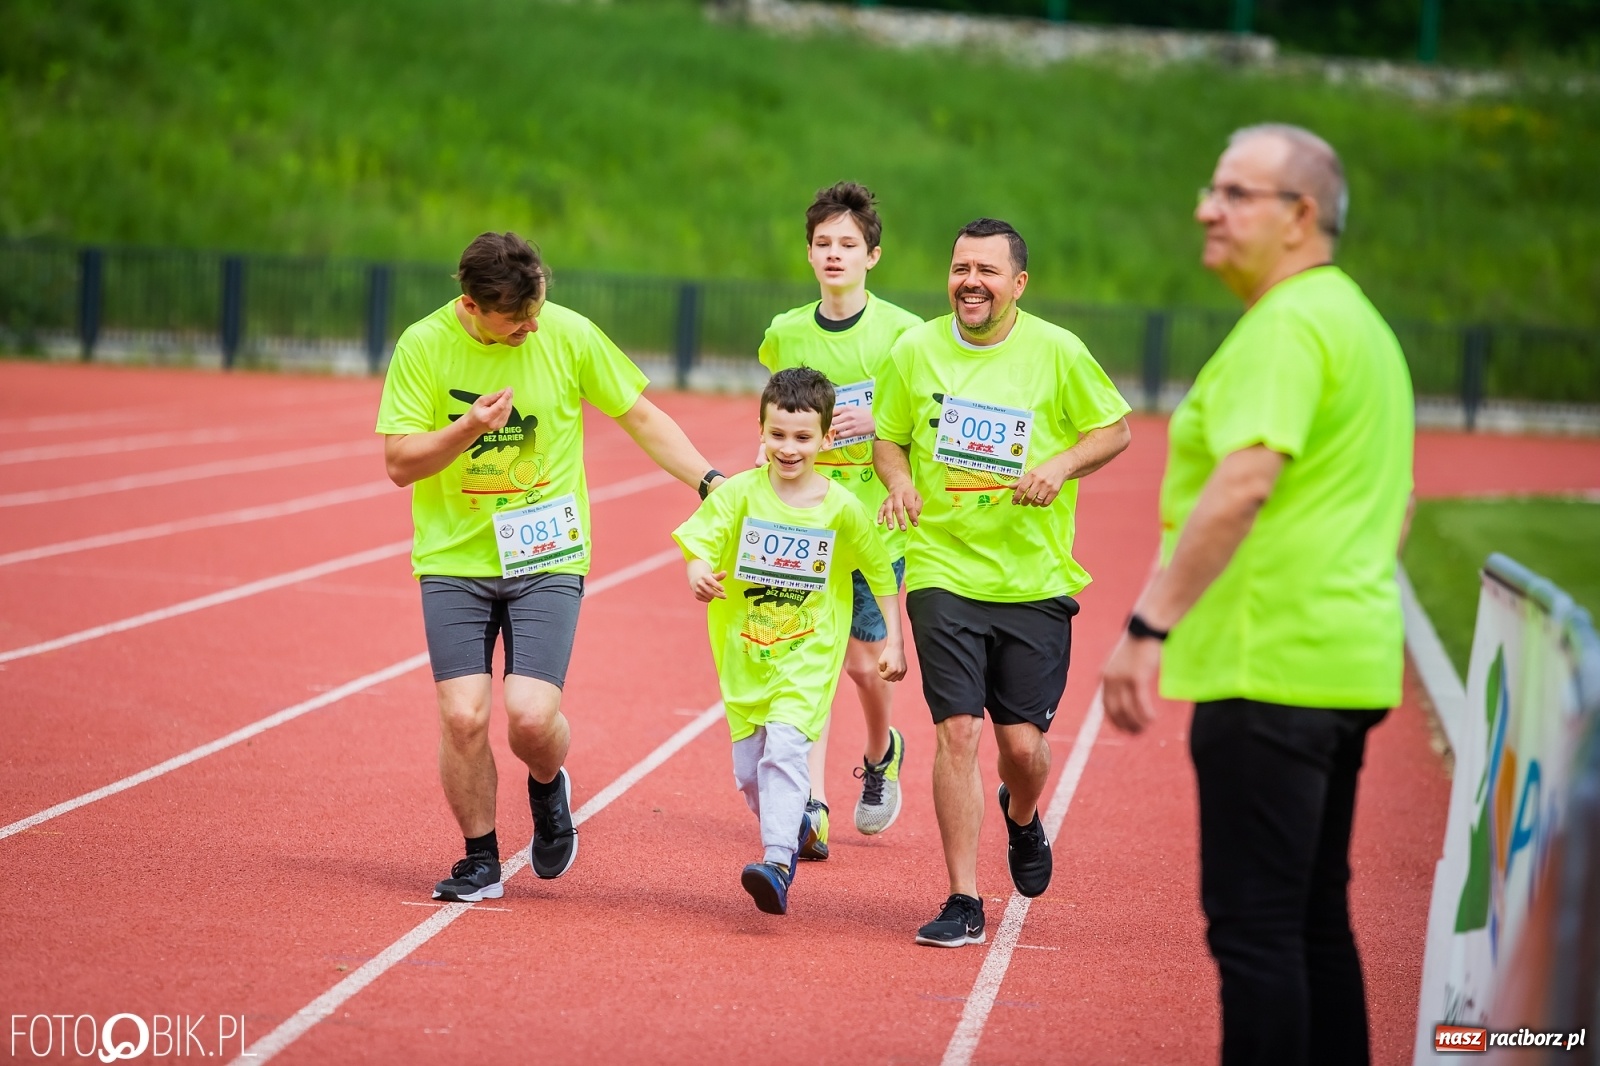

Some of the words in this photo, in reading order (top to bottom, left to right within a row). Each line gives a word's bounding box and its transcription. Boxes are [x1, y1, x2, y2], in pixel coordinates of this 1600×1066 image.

[504, 426, 522, 434] BIEG
[961, 417, 1006, 444] 003
[1015, 420, 1026, 433] R
[483, 434, 497, 442] BEZ
[498, 433, 524, 442] BARIER
[564, 506, 574, 518] R
[520, 516, 562, 545] 081
[764, 534, 810, 559] 078
[818, 540, 828, 552] R
[766, 589, 779, 597] BEZ
